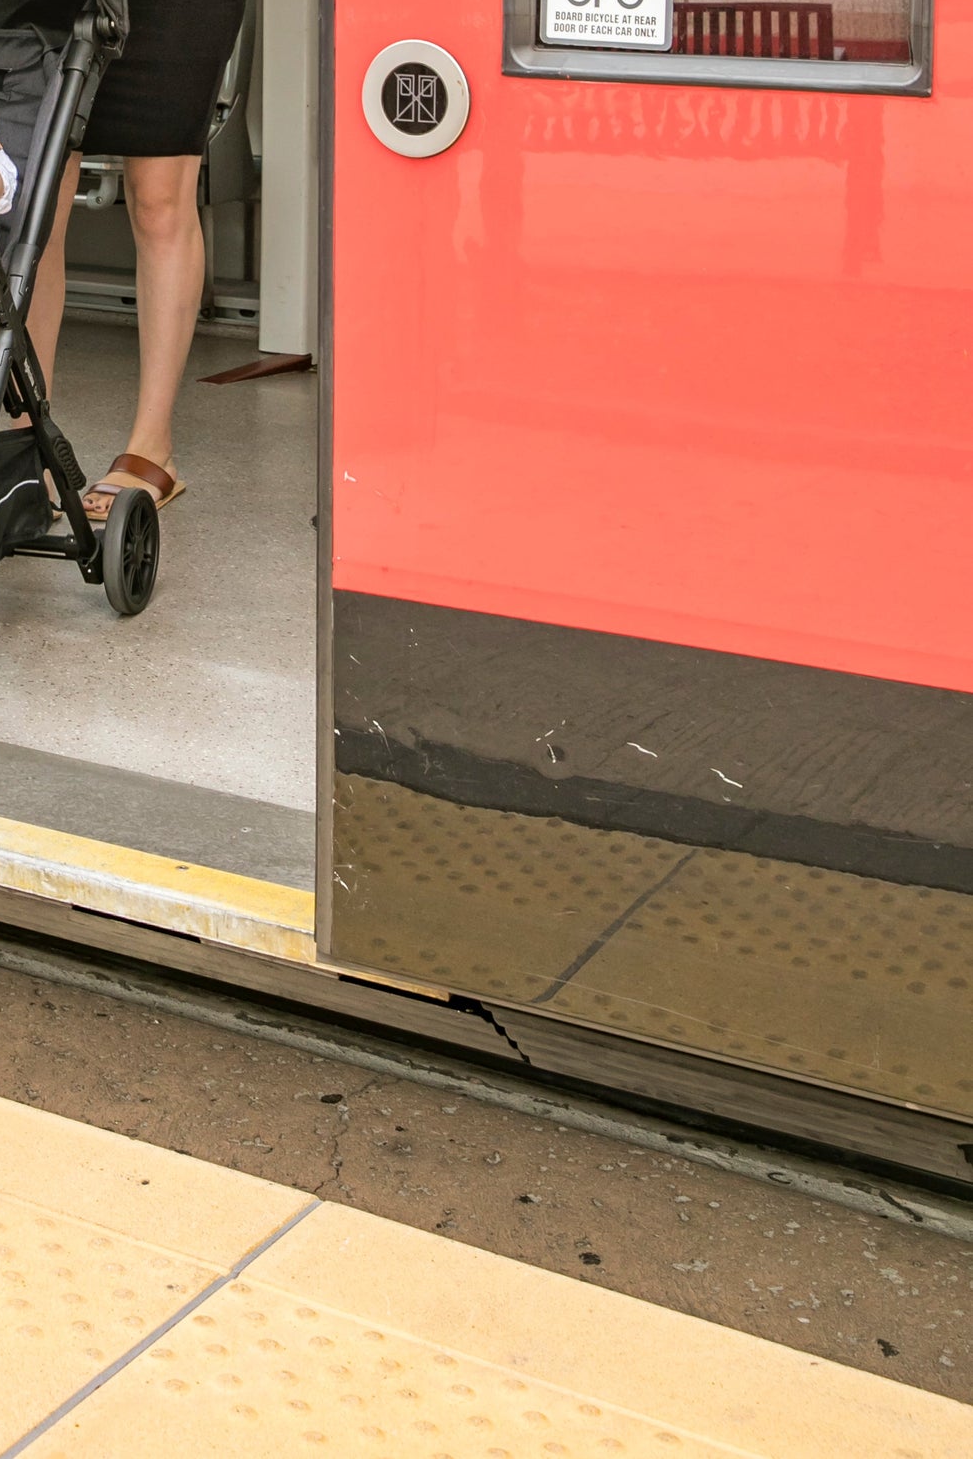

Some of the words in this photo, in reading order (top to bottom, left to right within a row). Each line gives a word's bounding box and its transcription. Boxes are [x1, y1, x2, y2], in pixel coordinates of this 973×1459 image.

[555, 10, 583, 21] BOARD
[585, 12, 620, 24] BICYCLE
[622, 14, 632, 24] AT
[634, 16, 657, 26] REAR
[554, 22, 576, 33] DOOR
[578, 24, 588, 34] OF
[591, 25, 613, 36] EACH
[615, 26, 632, 37] CAR
[634, 28, 658, 38] ONLY.
